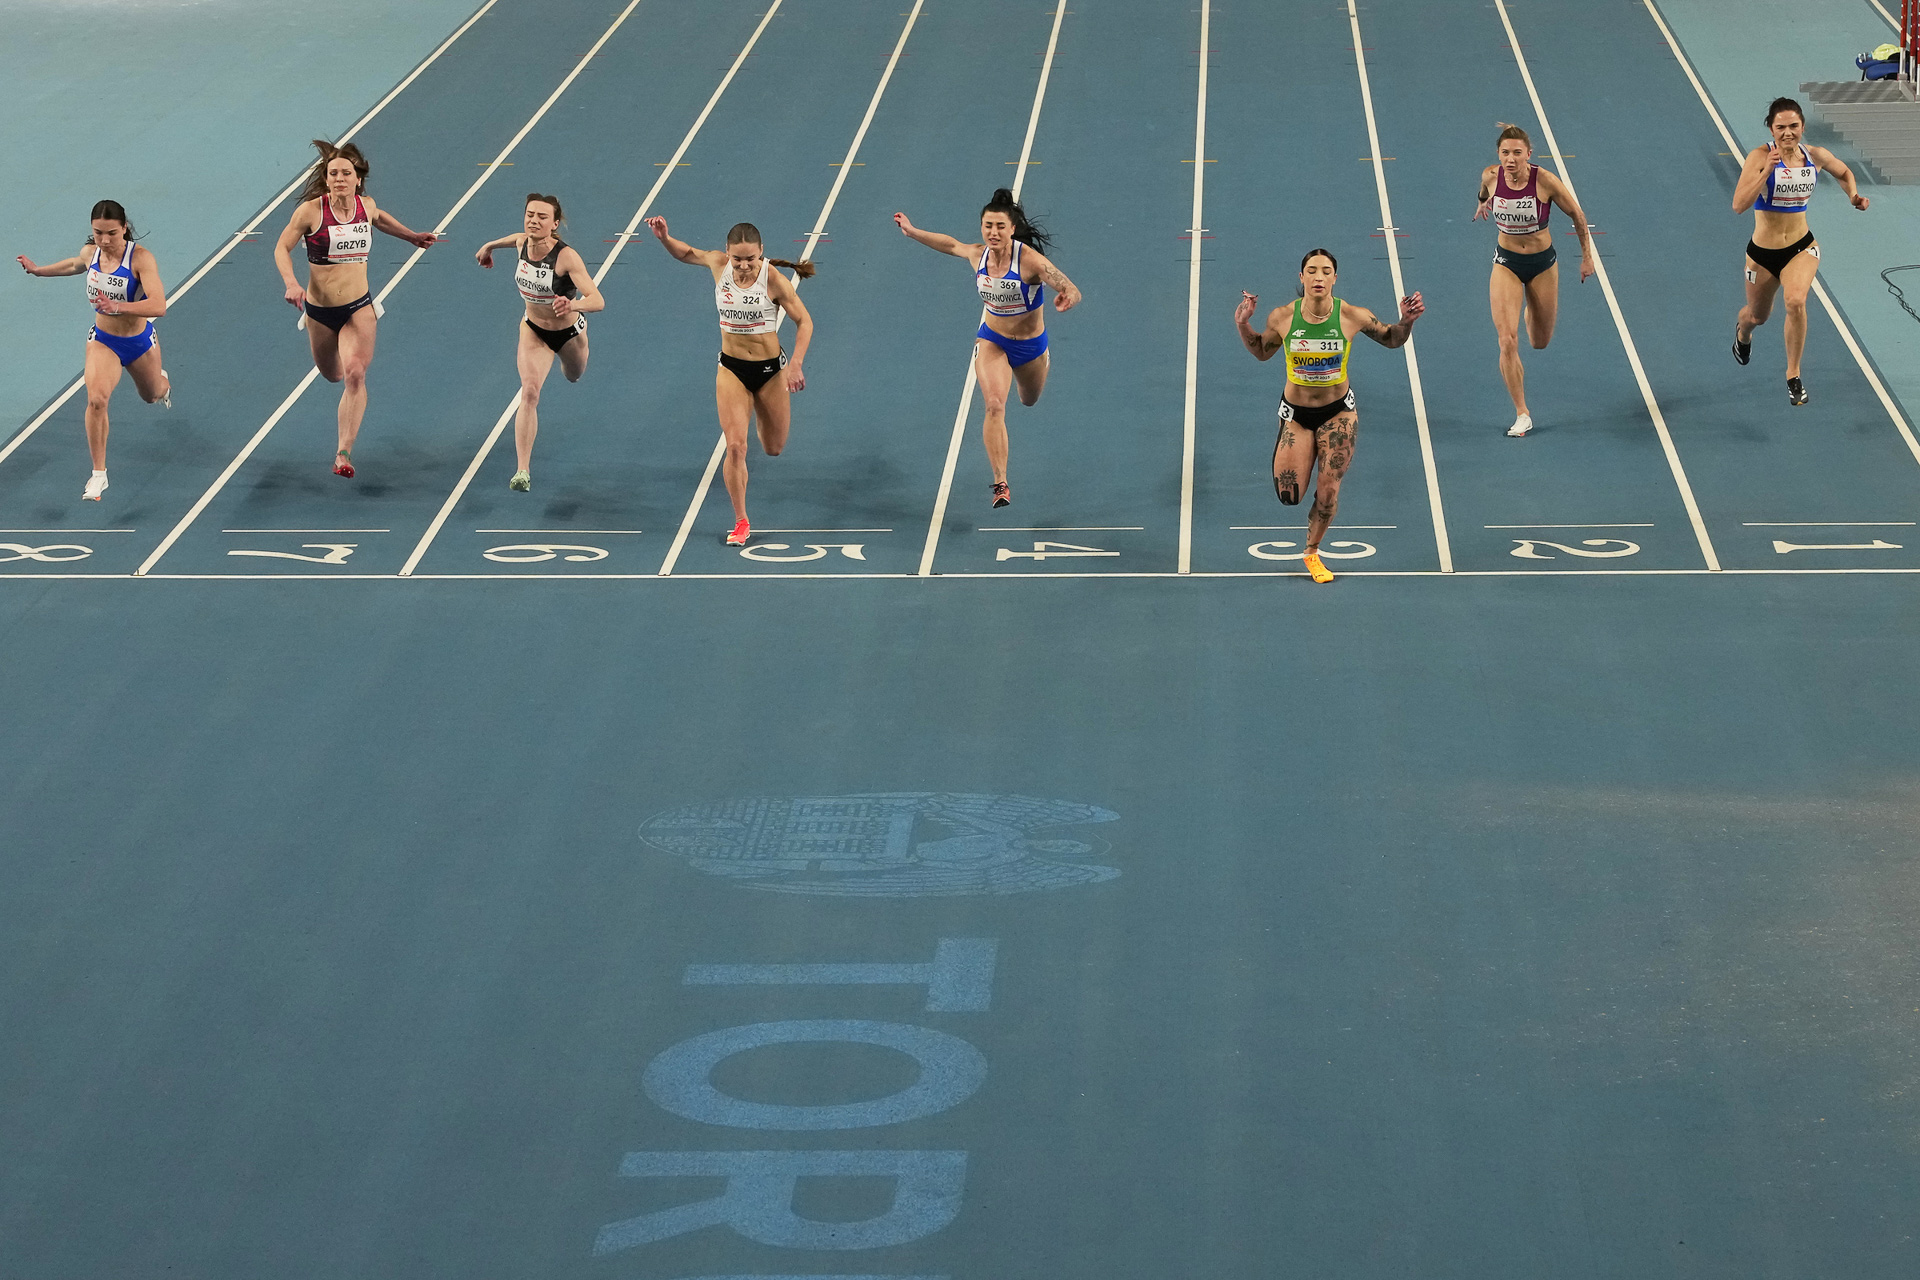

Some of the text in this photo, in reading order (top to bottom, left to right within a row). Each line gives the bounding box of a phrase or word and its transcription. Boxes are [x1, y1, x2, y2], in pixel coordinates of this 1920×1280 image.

[1800, 169, 1811, 177] 89
[1776, 183, 1814, 193] ROMASZKO
[1516, 201, 1532, 209] 222
[1494, 212, 1536, 222] KOTWIŁA
[353, 225, 368, 233] 461
[336, 239, 367, 250] GRZYB
[535, 270, 547, 279] 19
[1747, 271, 1752, 281] 1
[107, 276, 124, 288] 358
[1000, 281, 1017, 290] 369
[742, 295, 760, 305] 324
[980, 290, 1022, 303] STEFANOWICZ
[1320, 341, 1339, 350] 311
[1293, 356, 1340, 366] SWOBODA
[1281, 405, 1290, 419] 3
[0, 543, 93, 562] 8
[996, 541, 1121, 562] 4
[1248, 541, 1377, 561] 3
[1510, 539, 1640, 559] 2
[1773, 540, 1904, 554] 1
[228, 543, 358, 564] 7
[483, 544, 609, 562] 6
[739, 544, 866, 562] 5
[592, 938, 999, 1280] TOR
